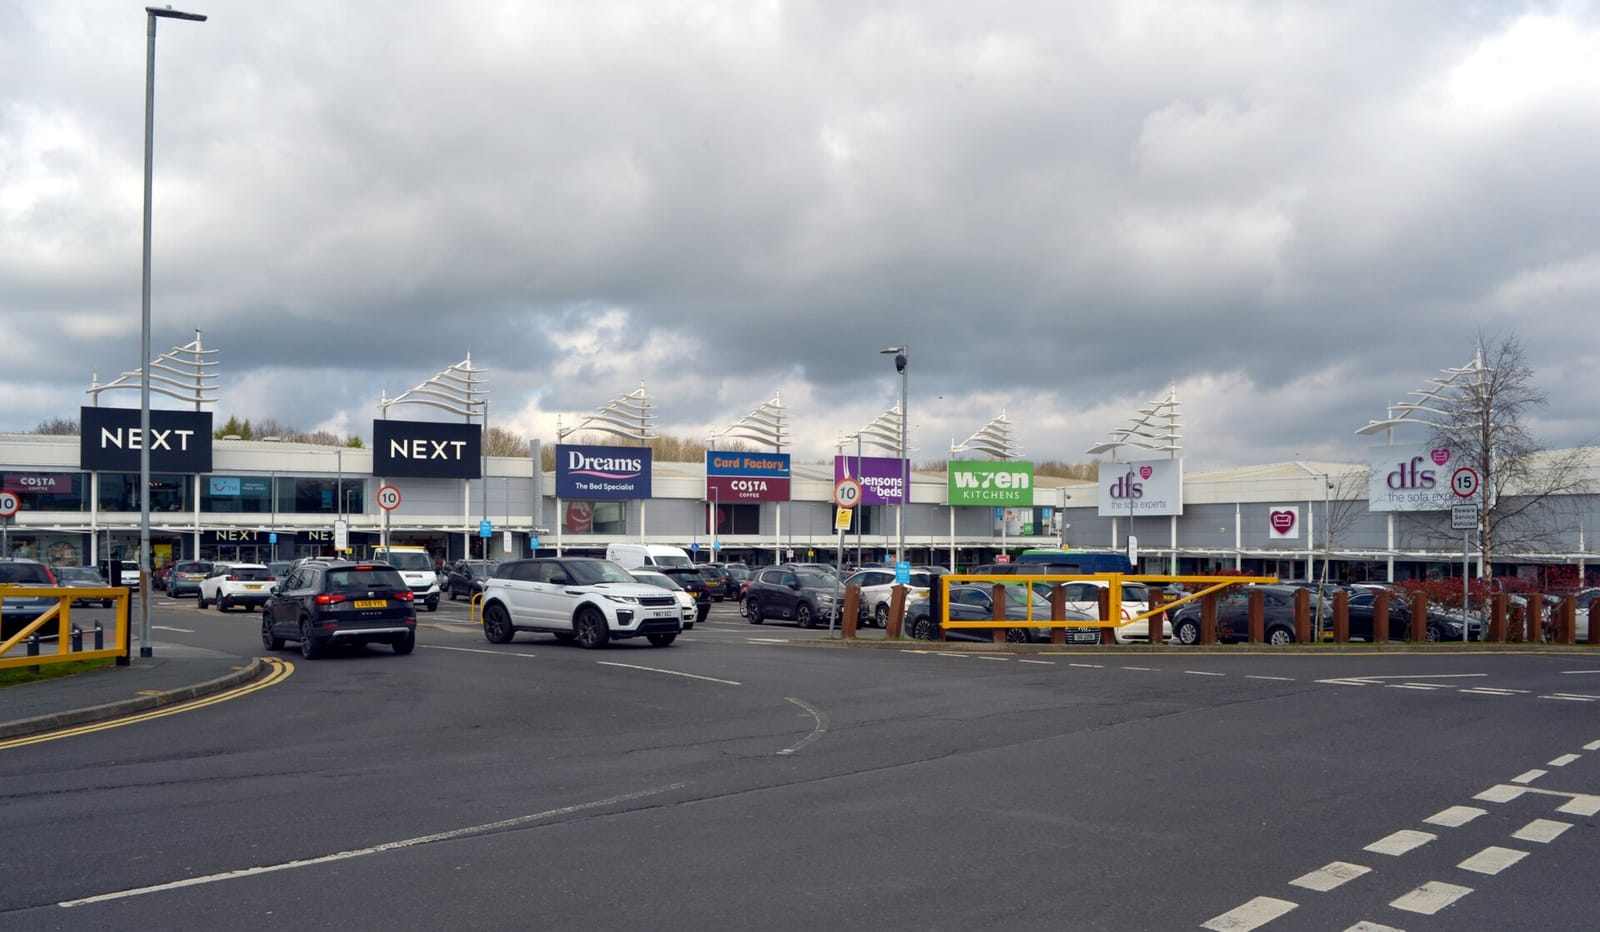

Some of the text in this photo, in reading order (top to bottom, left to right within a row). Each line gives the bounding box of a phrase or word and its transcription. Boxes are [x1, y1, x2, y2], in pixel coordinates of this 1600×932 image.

[101, 427, 195, 451] NEXT
[390, 439, 467, 460] NEXT
[568, 451, 642, 472] Dreams
[714, 457, 784, 472] Card Factory
[1387, 456, 1437, 490] dfs
[20, 477, 56, 486] COSTA
[731, 480, 767, 492] COSTA
[954, 471, 1030, 489] wren
[1109, 471, 1143, 499] dfs
[1457, 476, 1472, 488] 15
[576, 482, 588, 490] The
[603, 483, 634, 492] Specialist
[877, 485, 902, 497] beds
[382, 493, 397, 503] 10
[840, 487, 856, 500] 10
[963, 490, 1020, 500] KITCHENS
[1389, 492, 1404, 502] the
[1407, 491, 1429, 503] sofa
[1141, 501, 1167, 510] experts
[216, 529, 258, 541] NEXT
